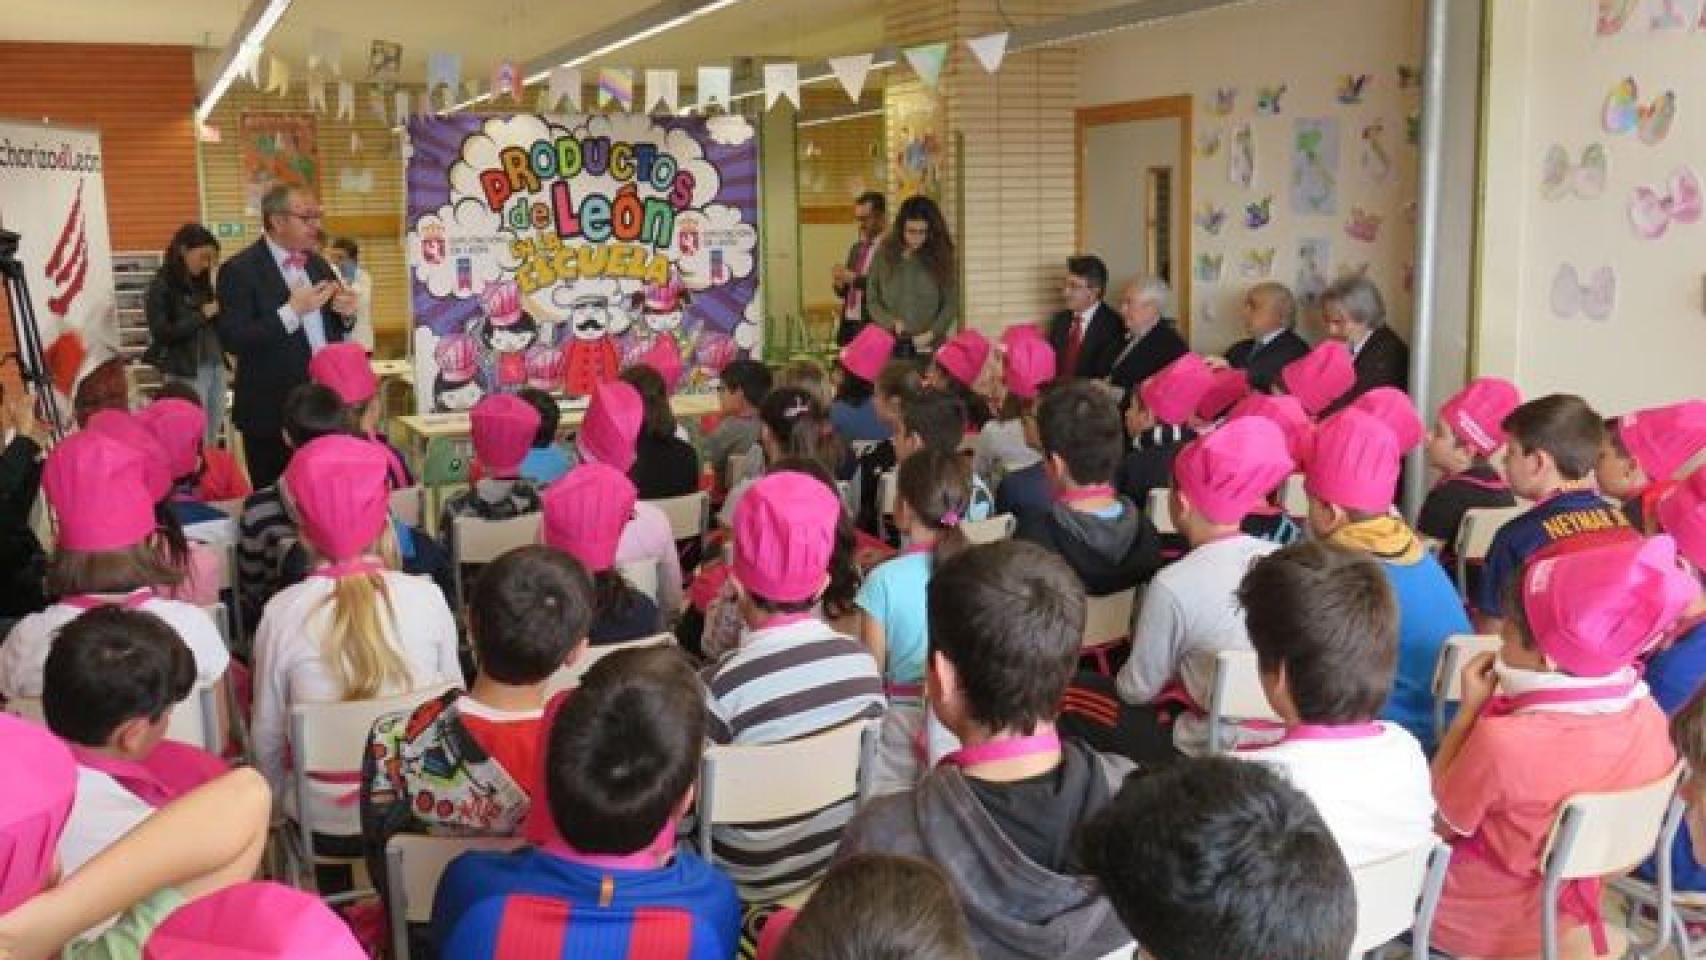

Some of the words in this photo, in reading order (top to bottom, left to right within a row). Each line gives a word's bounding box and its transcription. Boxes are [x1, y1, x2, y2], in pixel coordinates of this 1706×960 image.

[480, 136, 695, 212] PRODUCTOS
[509, 197, 550, 229] de
[516, 243, 669, 293] ESCUELA
